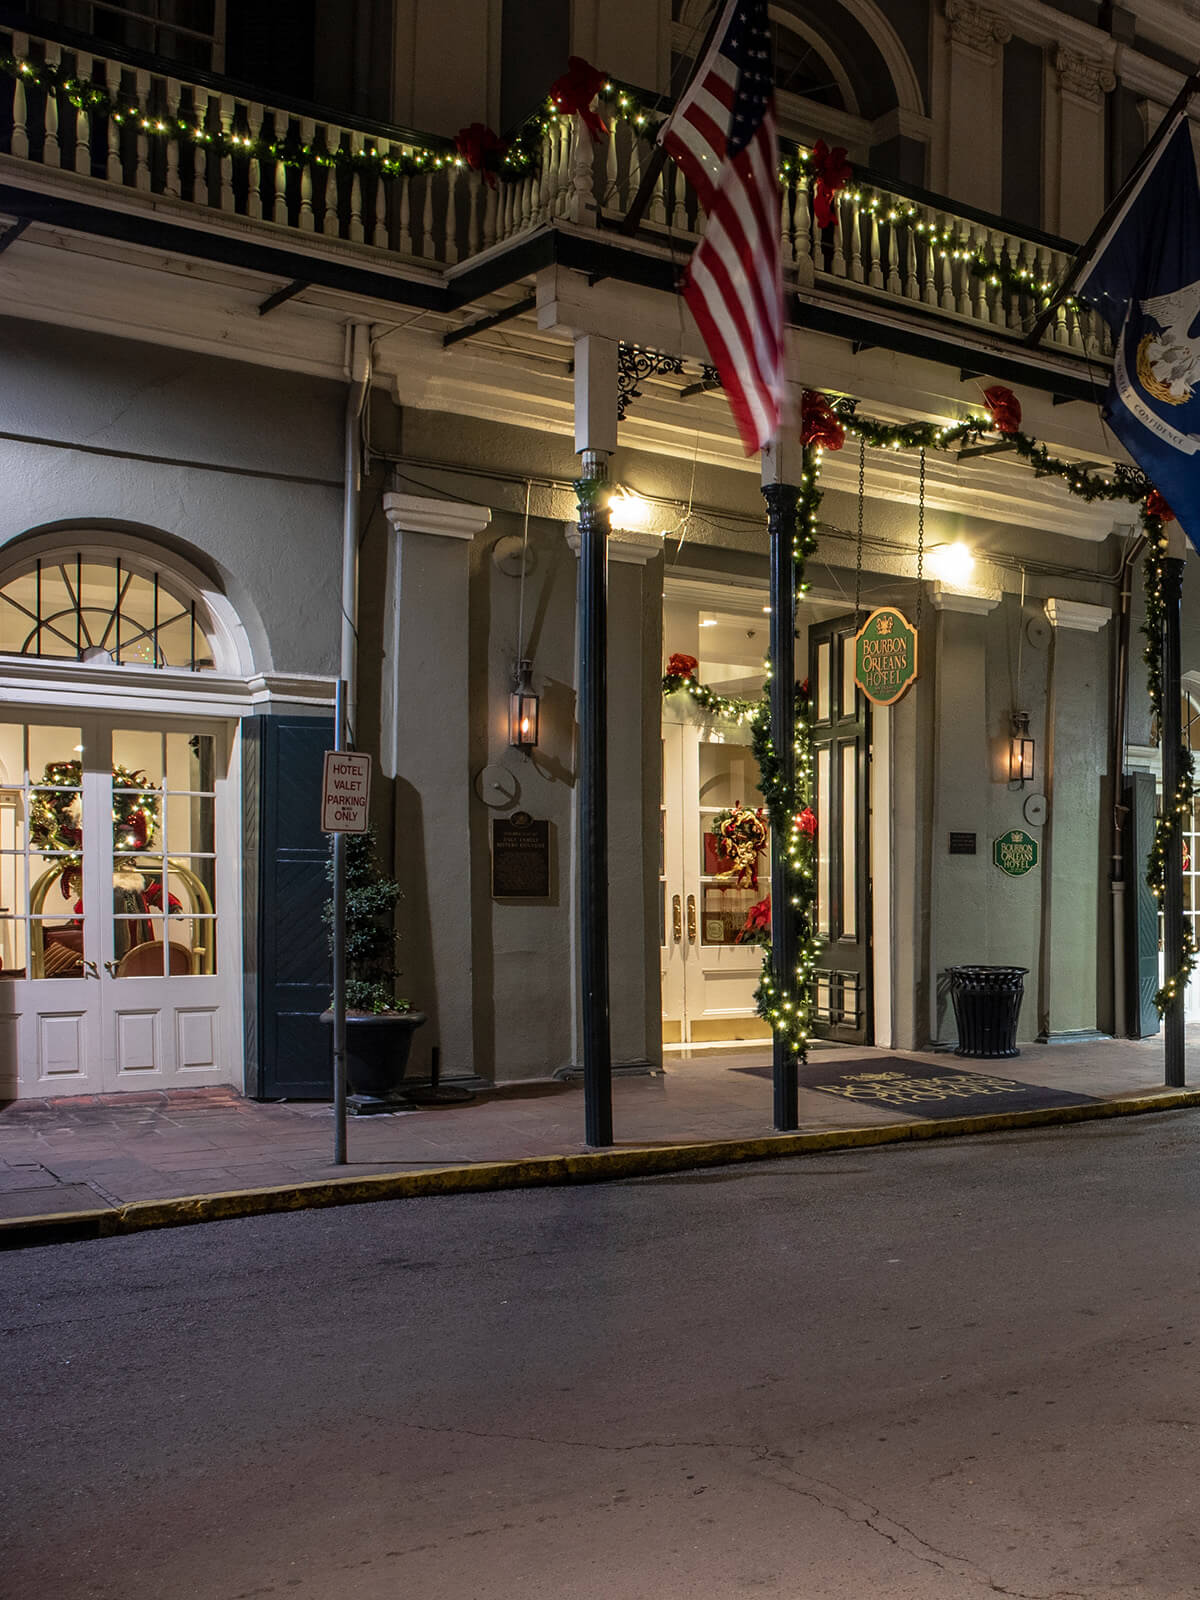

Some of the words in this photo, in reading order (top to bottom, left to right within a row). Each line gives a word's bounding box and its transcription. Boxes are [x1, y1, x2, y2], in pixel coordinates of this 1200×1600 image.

[1133, 403, 1185, 445] CONFIDENCE
[863, 636, 907, 655] BOURBON
[862, 654, 907, 673] ORLEANS
[866, 671, 902, 687] HOTEL
[333, 763, 363, 776] HOTEL
[334, 779, 362, 791] VALET
[327, 794, 366, 807] PARKING
[334, 810, 358, 821] ONLY
[1001, 842, 1033, 853] BOURBON
[1001, 851, 1033, 862] ORLEANS
[1004, 860, 1030, 868] HOTEL
